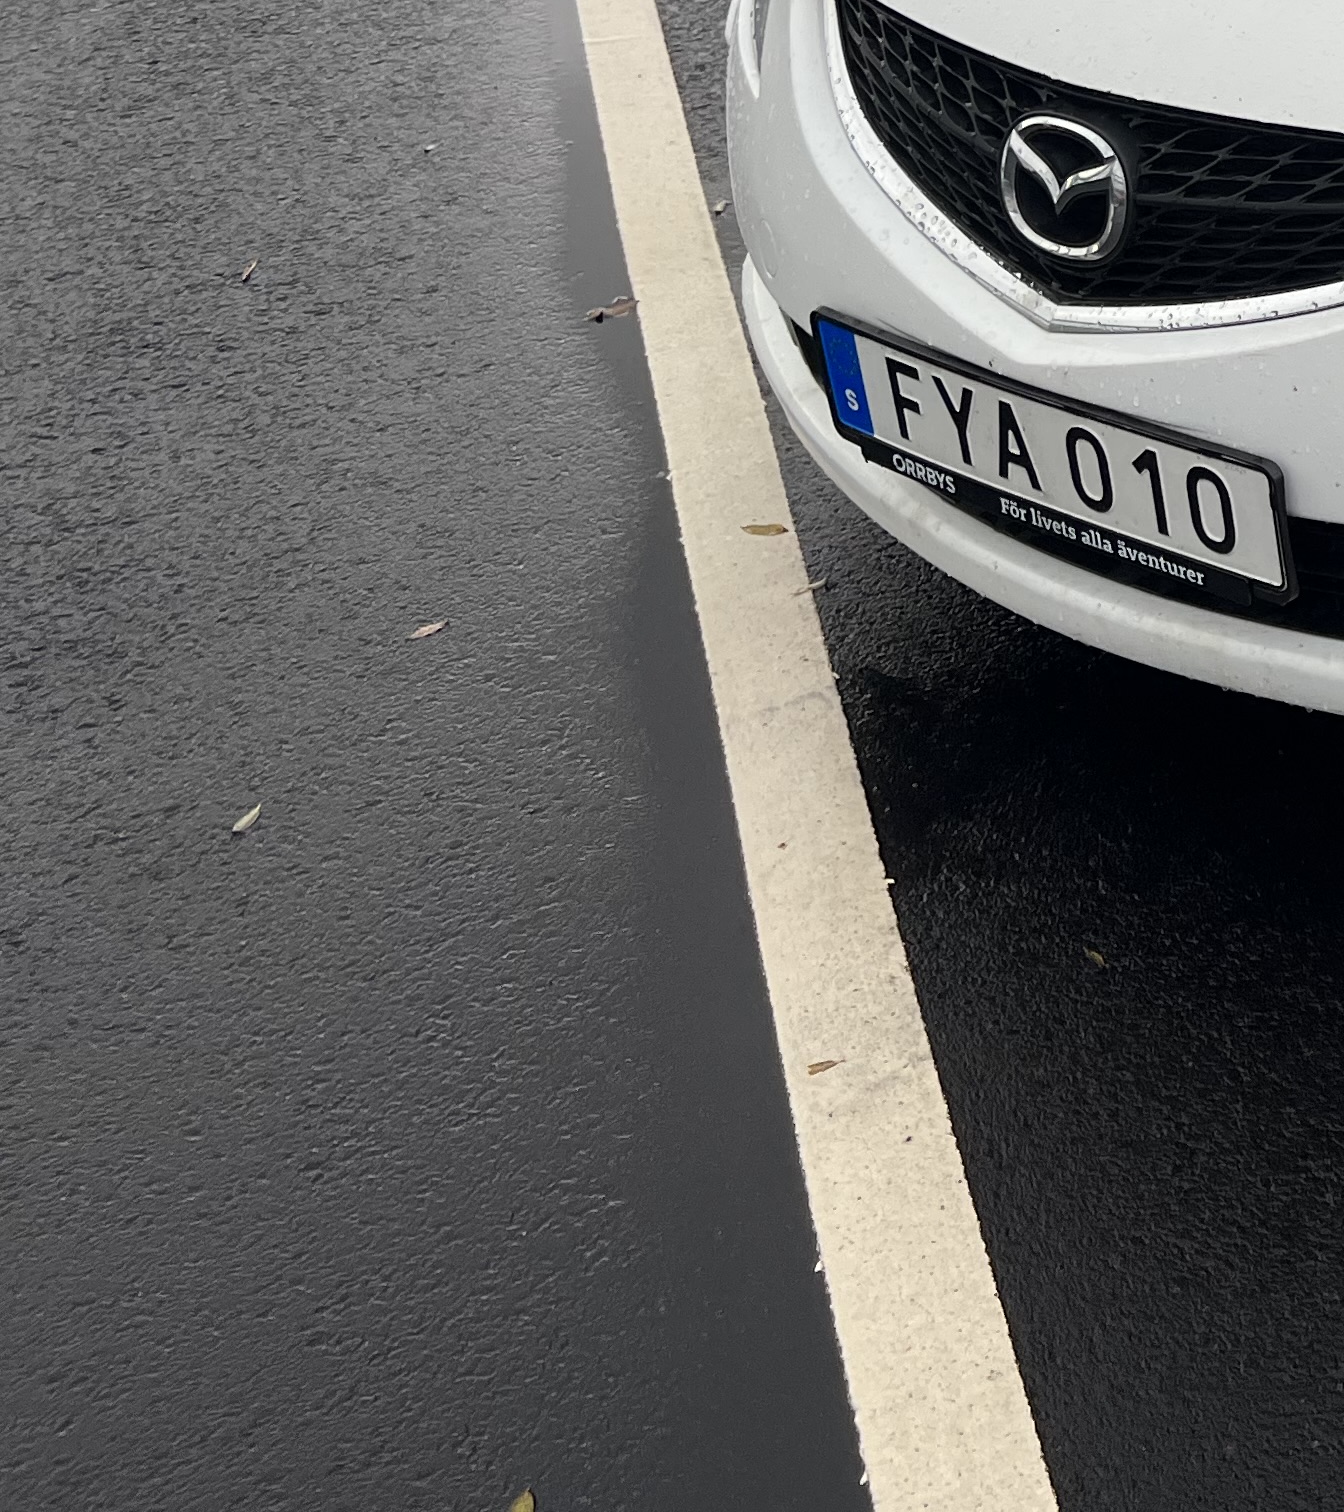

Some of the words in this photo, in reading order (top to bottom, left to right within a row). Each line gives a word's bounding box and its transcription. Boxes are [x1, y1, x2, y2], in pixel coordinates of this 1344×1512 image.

[846, 388, 860, 413] S
[886, 356, 1043, 491] FYA
[1065, 426, 1236, 554] 010
[892, 453, 956, 494] ORRBYS
[1000, 497, 1028, 522] För
[1031, 507, 1077, 540] livets
[1081, 529, 1114, 554] alla
[1117, 539, 1205, 586] äventurer
